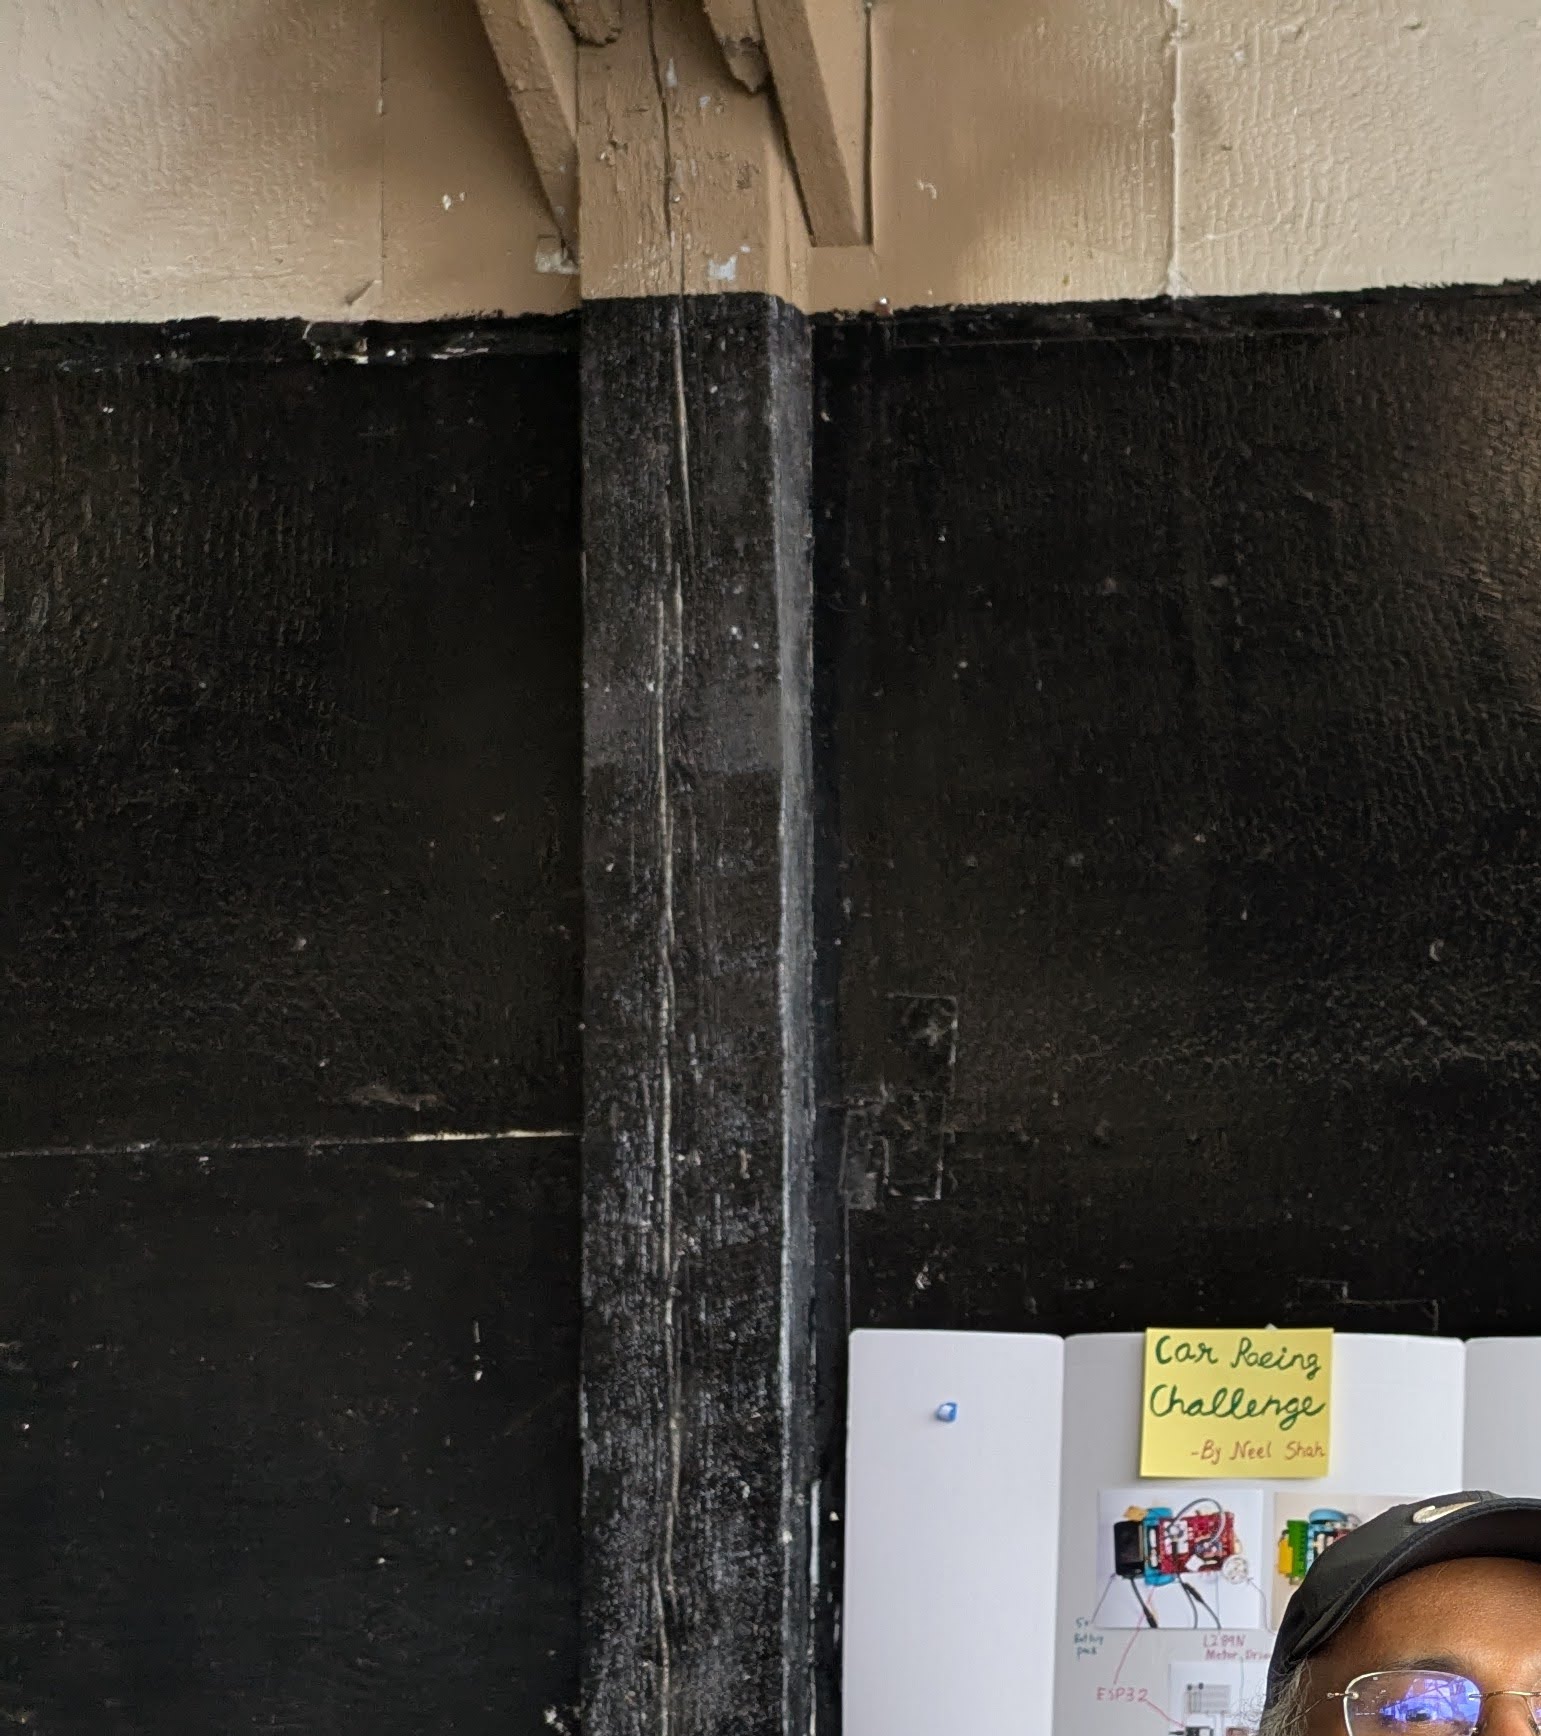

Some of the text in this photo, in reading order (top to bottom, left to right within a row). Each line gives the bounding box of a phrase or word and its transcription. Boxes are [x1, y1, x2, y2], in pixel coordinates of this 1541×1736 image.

[1155, 1336, 1218, 1364] Car
[1150, 1384, 1326, 1430] Challenge
[1230, 1441, 1271, 1460] Neel
[1286, 1441, 1326, 1460] Shah
[1096, 1686, 1148, 1702] ESP32
